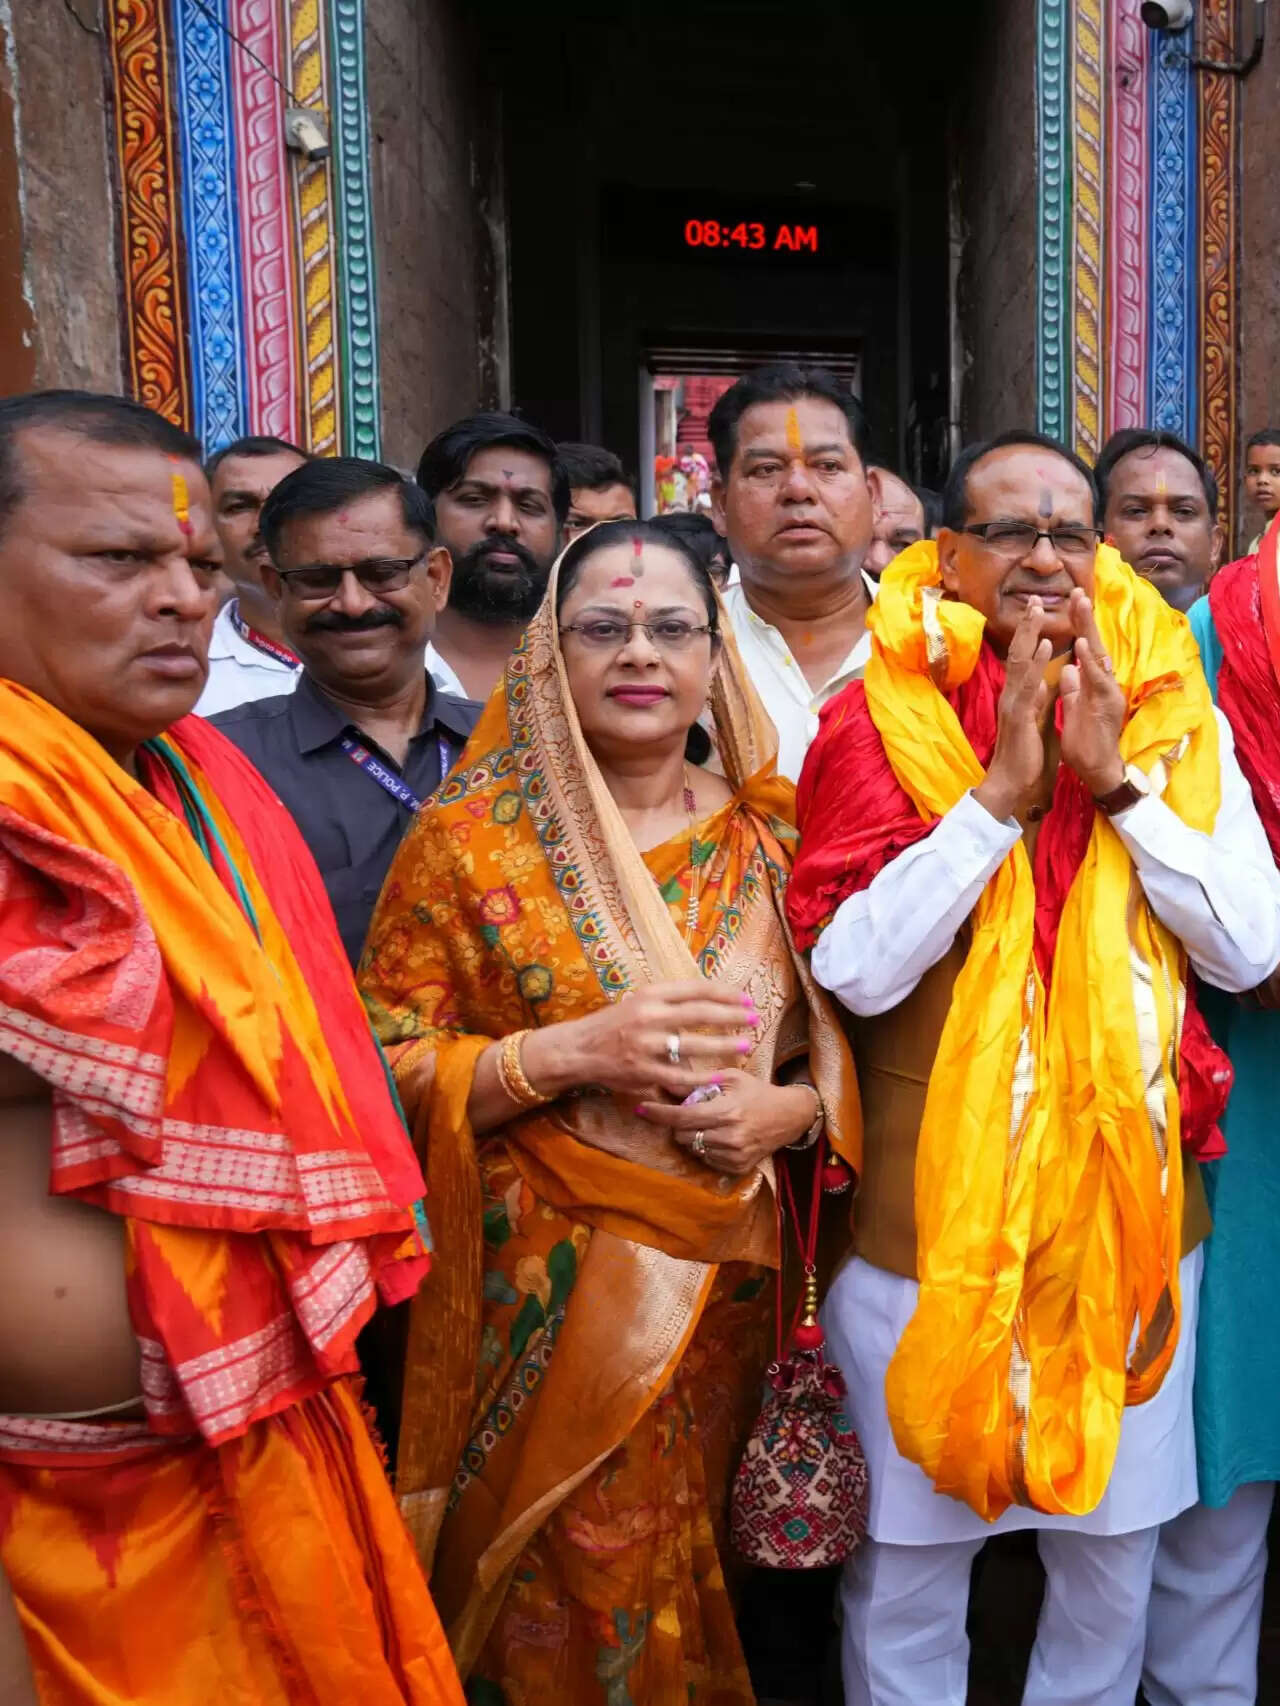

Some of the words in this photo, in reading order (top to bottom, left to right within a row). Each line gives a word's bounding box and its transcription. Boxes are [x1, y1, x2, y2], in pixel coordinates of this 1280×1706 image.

[685, 220, 765, 249] 08:43
[774, 224, 817, 252] AM
[367, 761, 402, 793] POLICE
